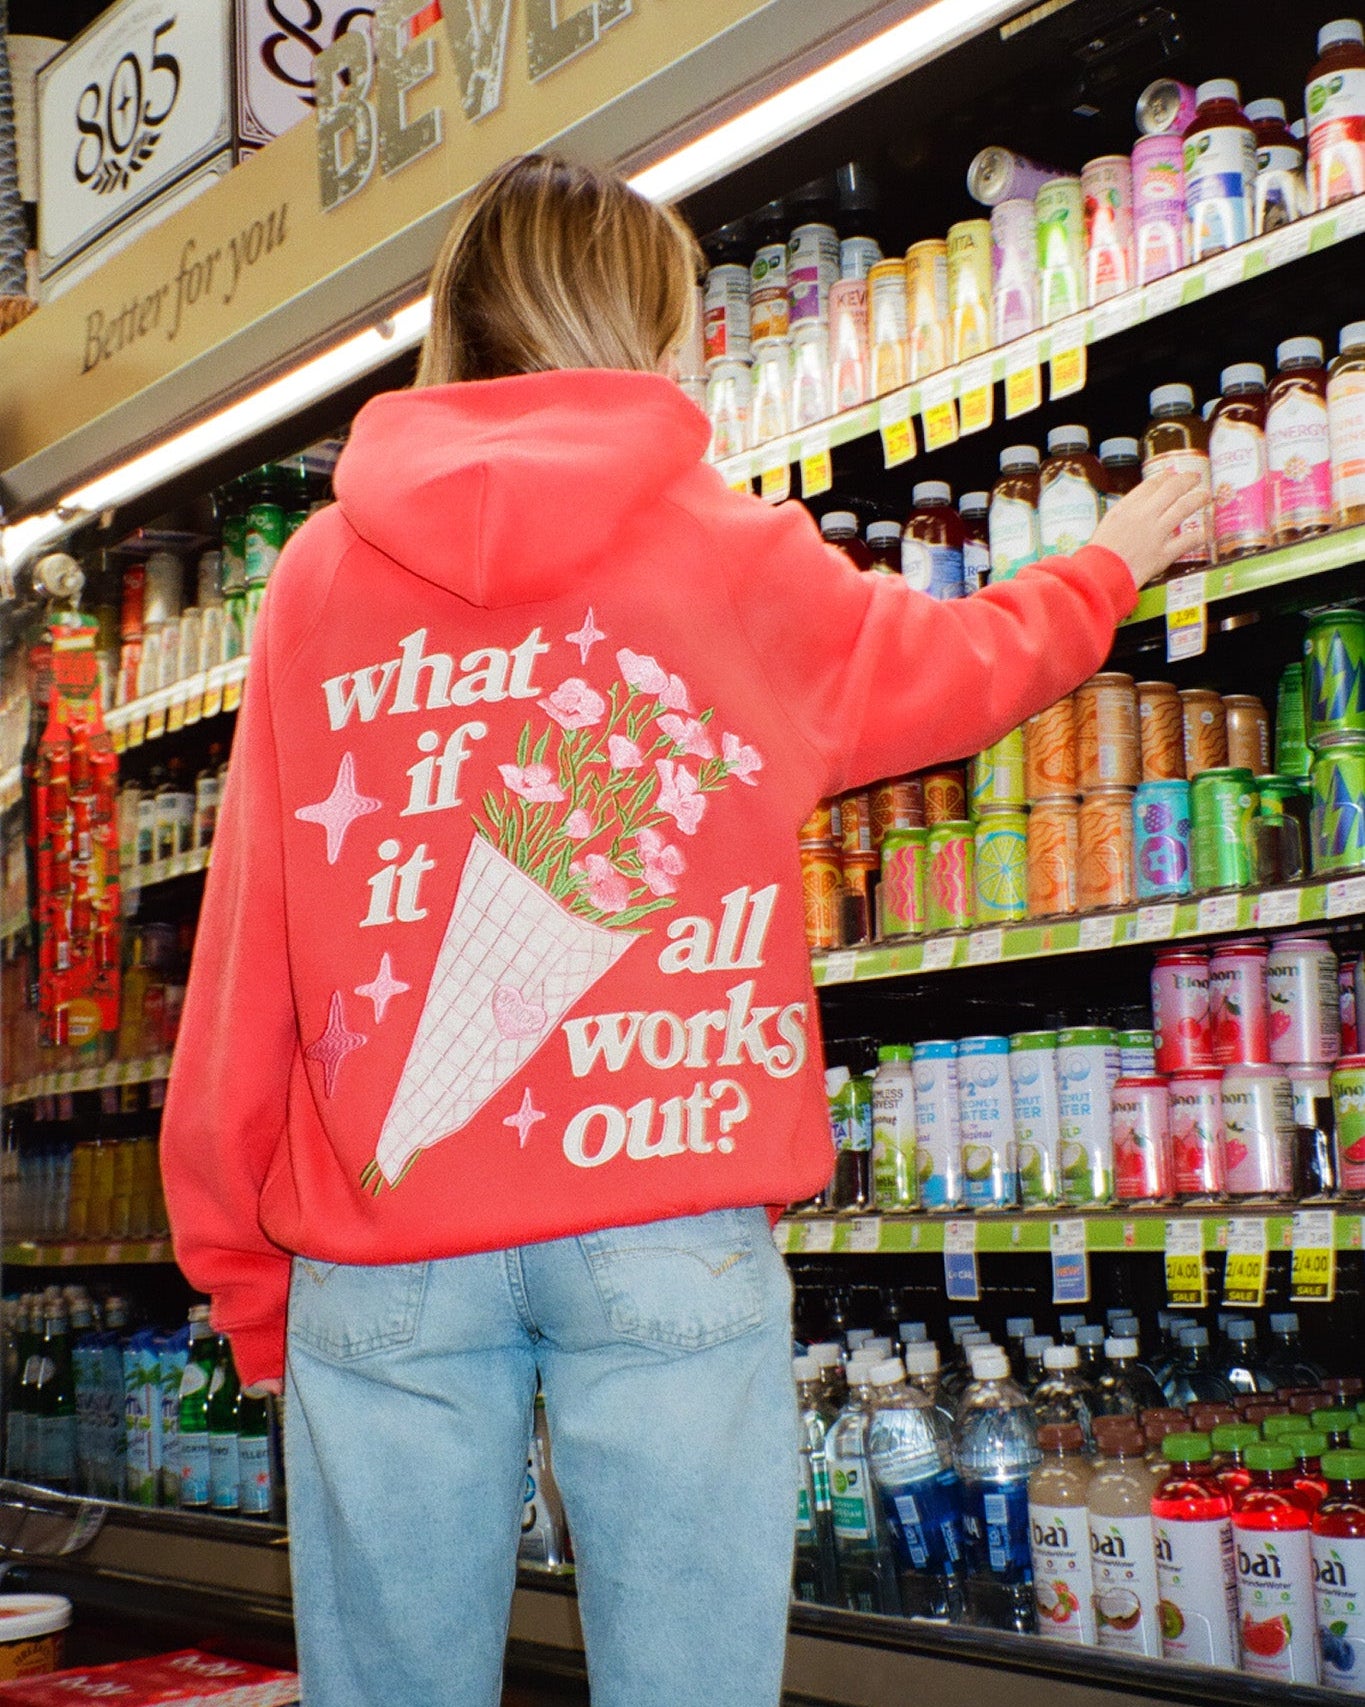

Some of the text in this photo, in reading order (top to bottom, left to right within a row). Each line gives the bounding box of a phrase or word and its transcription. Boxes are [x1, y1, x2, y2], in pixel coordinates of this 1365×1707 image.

[74, 15, 181, 184] 805
[81, 202, 287, 375] Better for you
[321, 626, 551, 731] what
[399, 720, 487, 817] if
[358, 838, 435, 928] it
[658, 883, 779, 974] all
[562, 979, 809, 1079] works
[562, 1080, 750, 1168] out?
[1166, 1263, 1200, 1280] 2/4.00
[1226, 1263, 1260, 1279] 2/4.00
[1291, 1255, 1328, 1273] 2/4.00
[1172, 1292, 1197, 1303] SALE
[1228, 1289, 1255, 1302] SALE
[1296, 1284, 1323, 1296] SALE
[1032, 1516, 1069, 1548] bai
[1089, 1525, 1127, 1559] bai
[1237, 1541, 1282, 1579] bai
